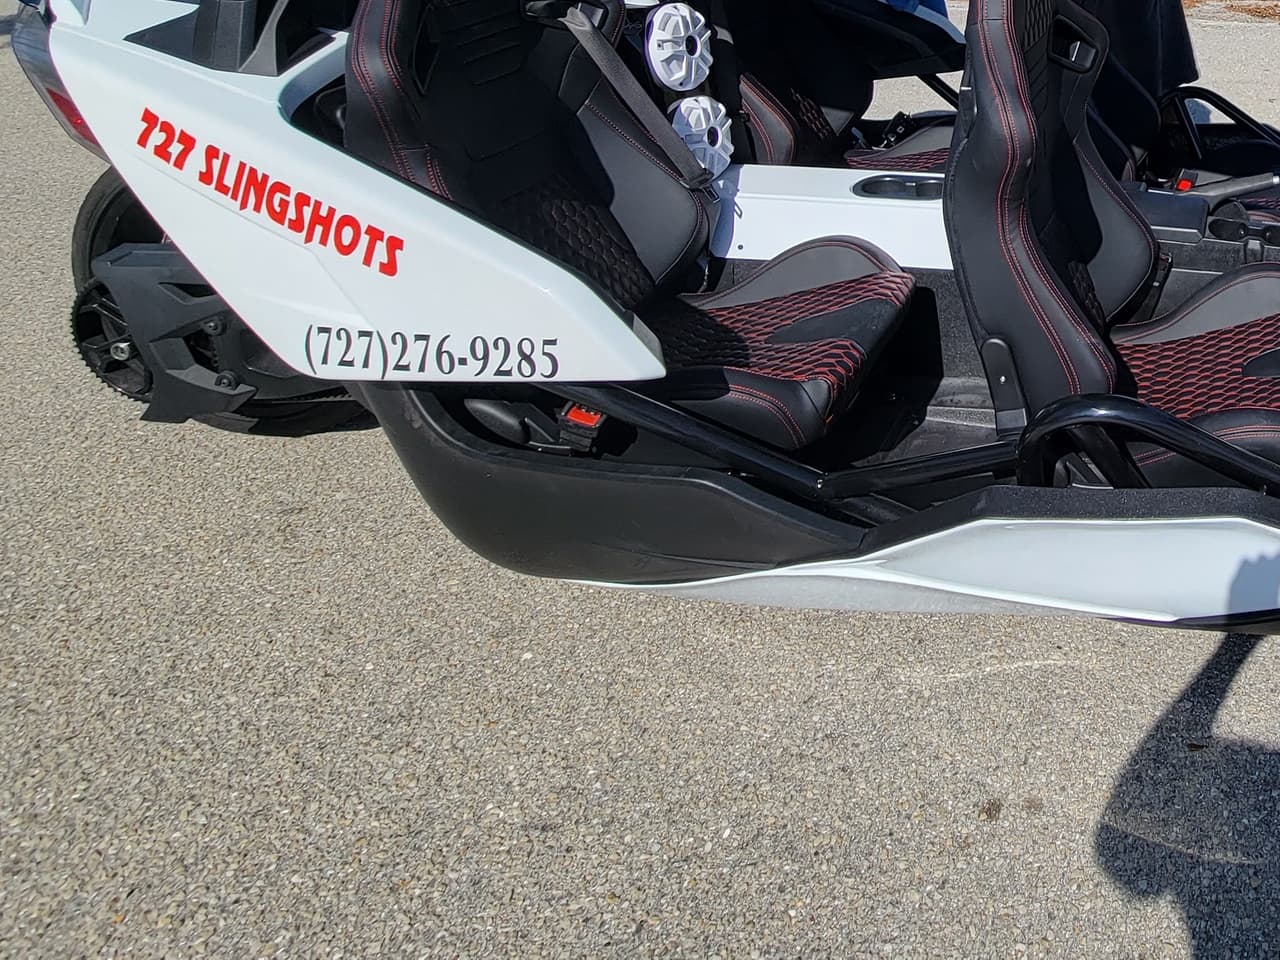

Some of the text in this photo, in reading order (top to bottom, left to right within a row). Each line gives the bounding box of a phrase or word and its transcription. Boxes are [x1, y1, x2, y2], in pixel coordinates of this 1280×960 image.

[136, 107, 404, 277] 727 SLINGSHOTS
[304, 324, 560, 380] (727)276-9285
